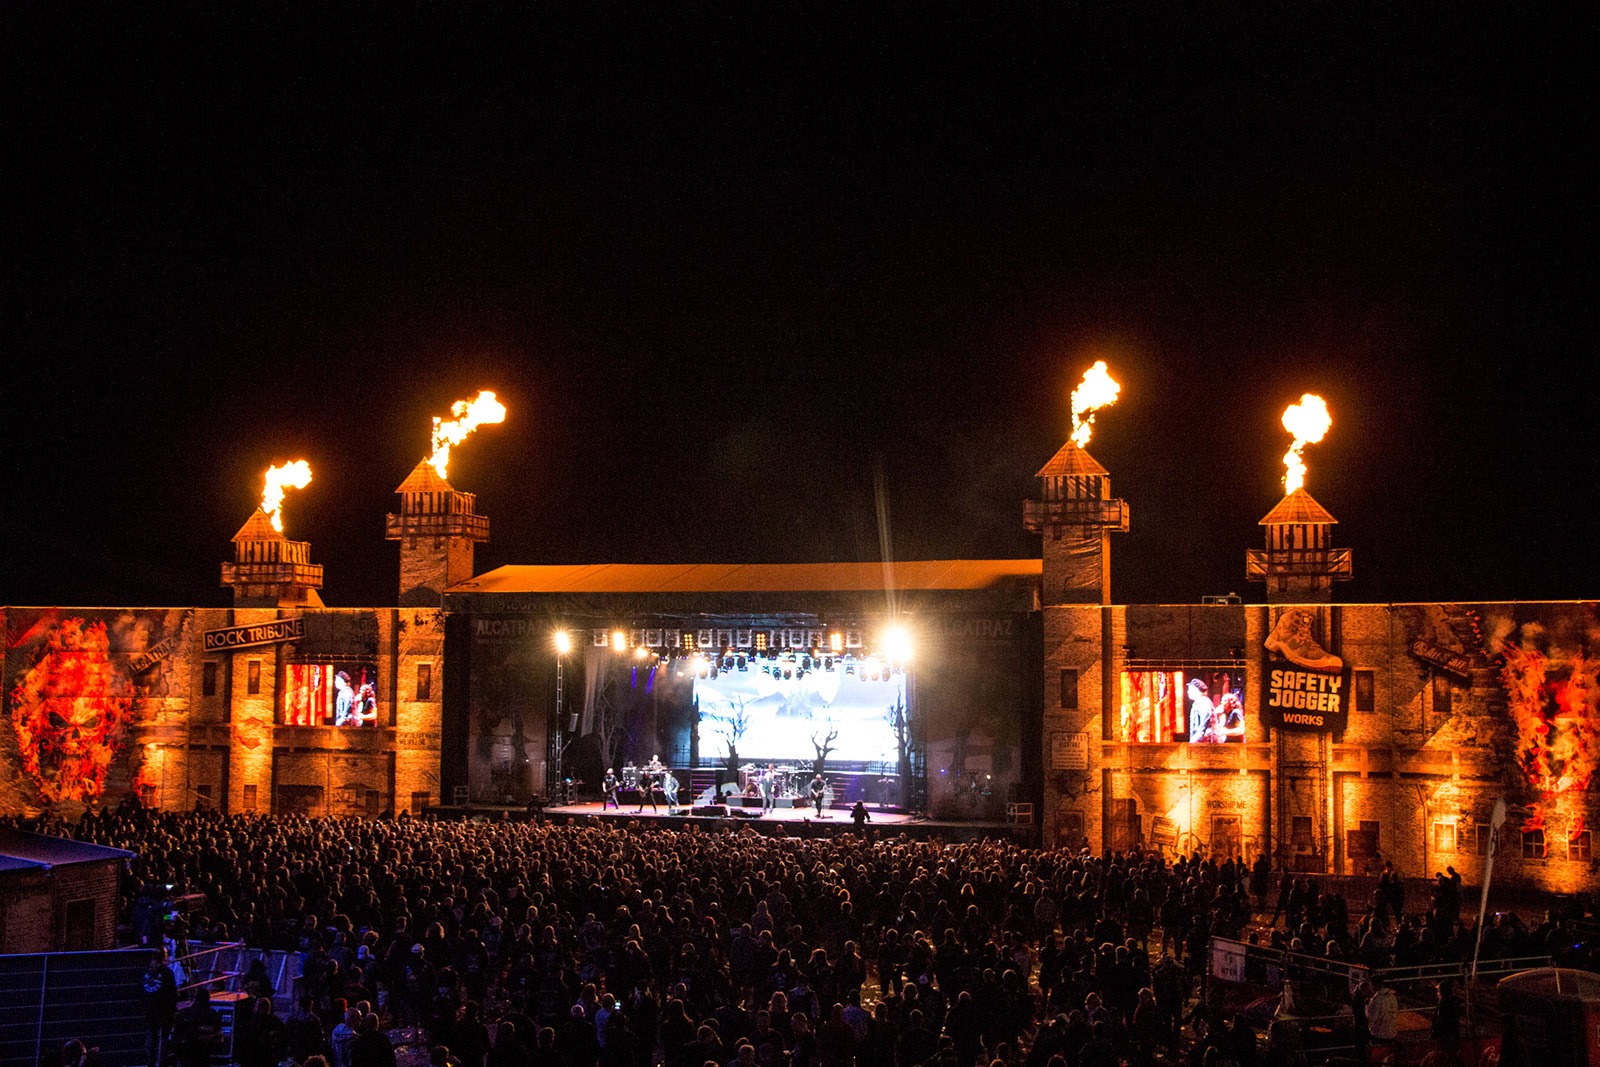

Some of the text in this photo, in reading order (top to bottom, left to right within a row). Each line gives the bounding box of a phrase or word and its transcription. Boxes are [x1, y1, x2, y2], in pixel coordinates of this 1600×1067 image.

[206, 621, 304, 648] ROCK TRIBUNE
[1270, 669, 1342, 693] SAFETY
[1268, 688, 1341, 713] JOGGER
[1283, 713, 1324, 726] WORKS
